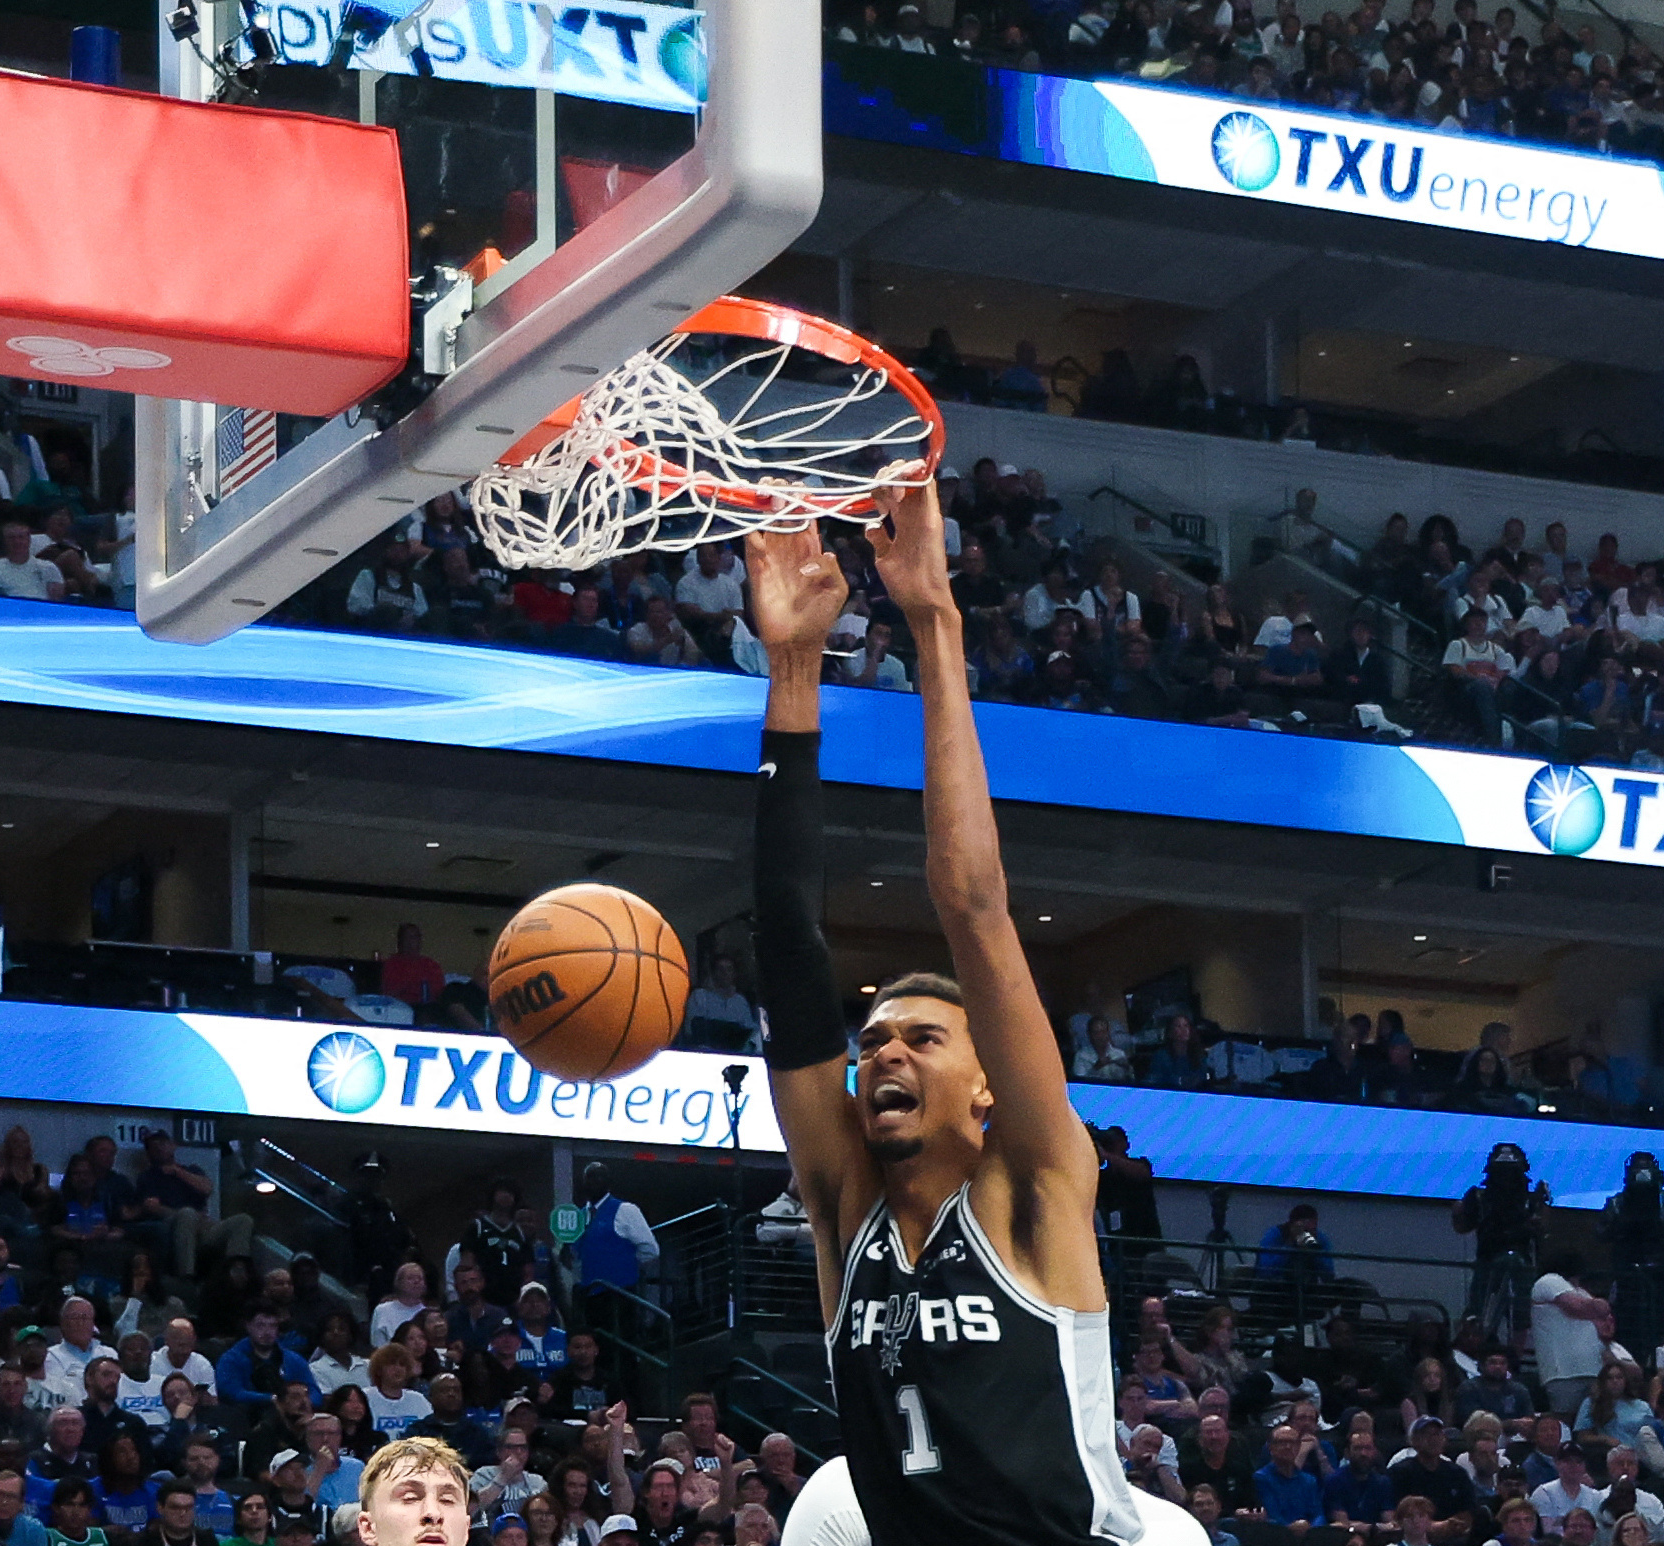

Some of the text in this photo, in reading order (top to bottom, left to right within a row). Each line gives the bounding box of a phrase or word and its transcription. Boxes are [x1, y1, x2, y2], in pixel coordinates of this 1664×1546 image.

[1286, 127, 1608, 247] TXU energy
[394, 1043, 540, 1117] TXU
[896, 1384, 943, 1476] 1
